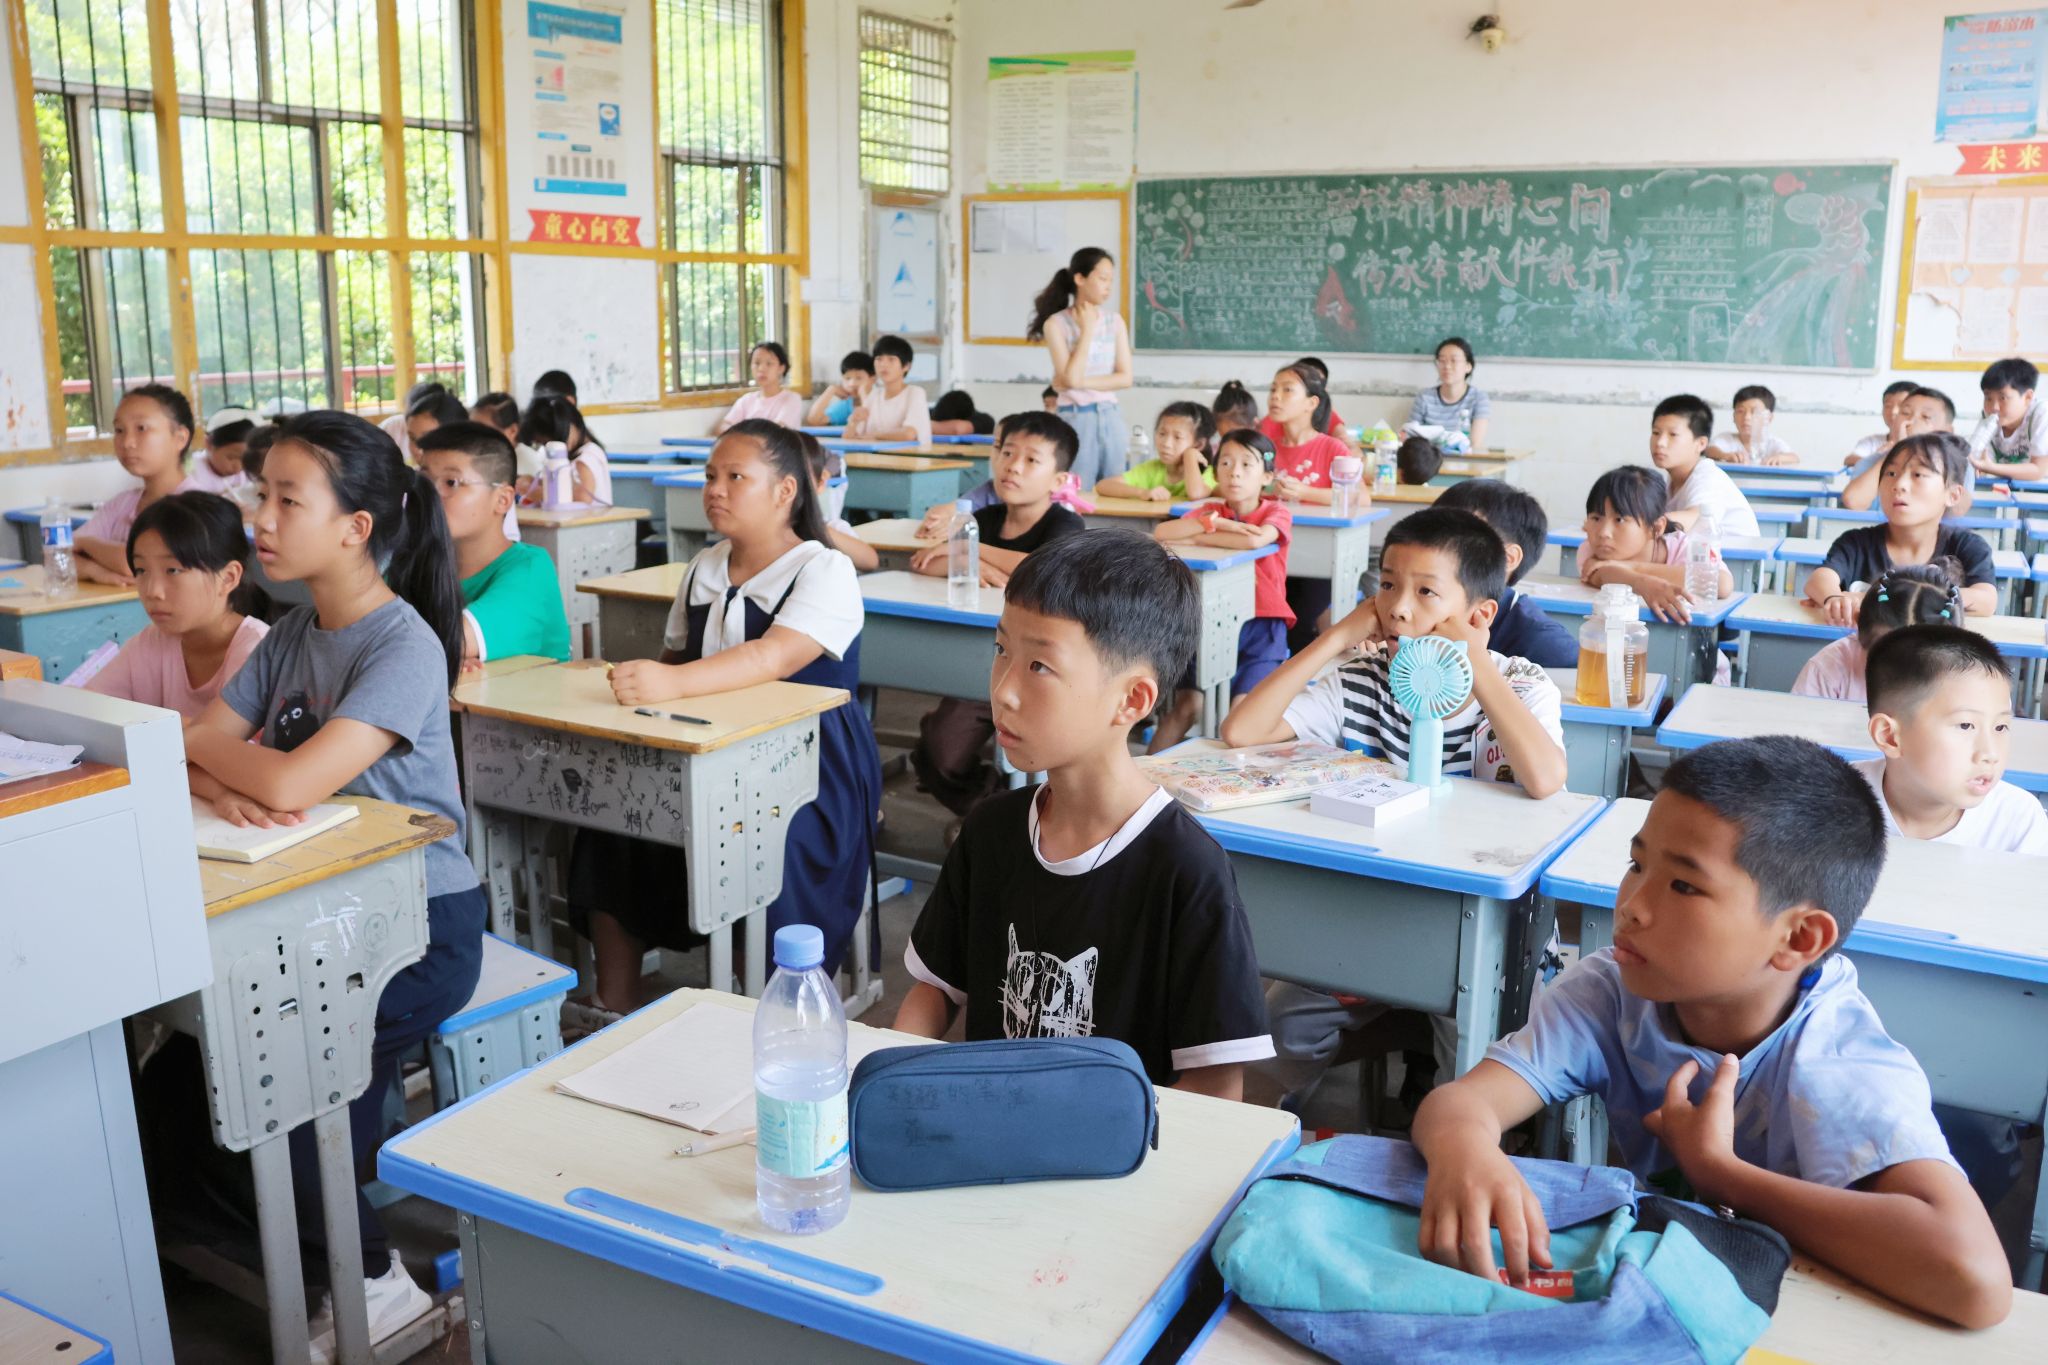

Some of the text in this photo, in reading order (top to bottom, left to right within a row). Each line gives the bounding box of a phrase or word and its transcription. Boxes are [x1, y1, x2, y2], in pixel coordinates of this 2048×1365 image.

[1981, 144, 2043, 172] 未来
[544, 211, 631, 245] 童心向党
[1352, 236, 1624, 302] 传承奉献伴我行
